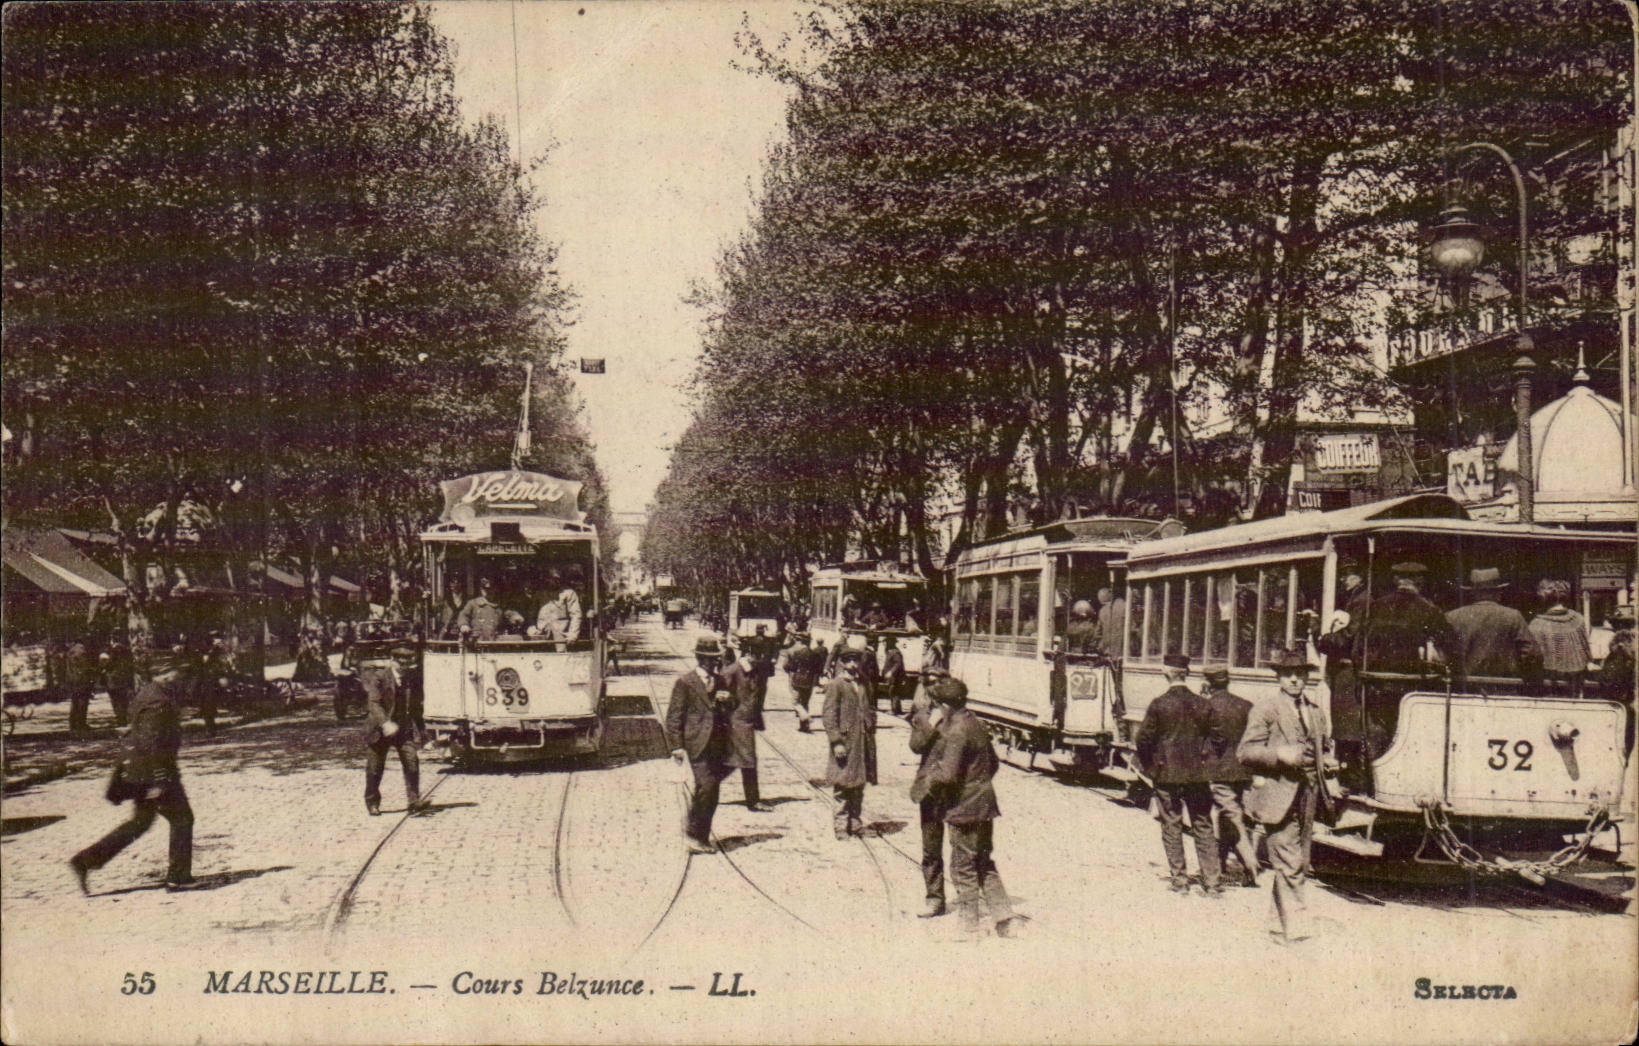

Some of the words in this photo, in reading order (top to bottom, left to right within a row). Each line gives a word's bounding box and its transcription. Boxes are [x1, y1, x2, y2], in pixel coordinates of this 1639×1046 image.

[461, 472, 564, 503] Velma
[485, 687, 529, 706] 839
[1487, 738, 1535, 771] 32
